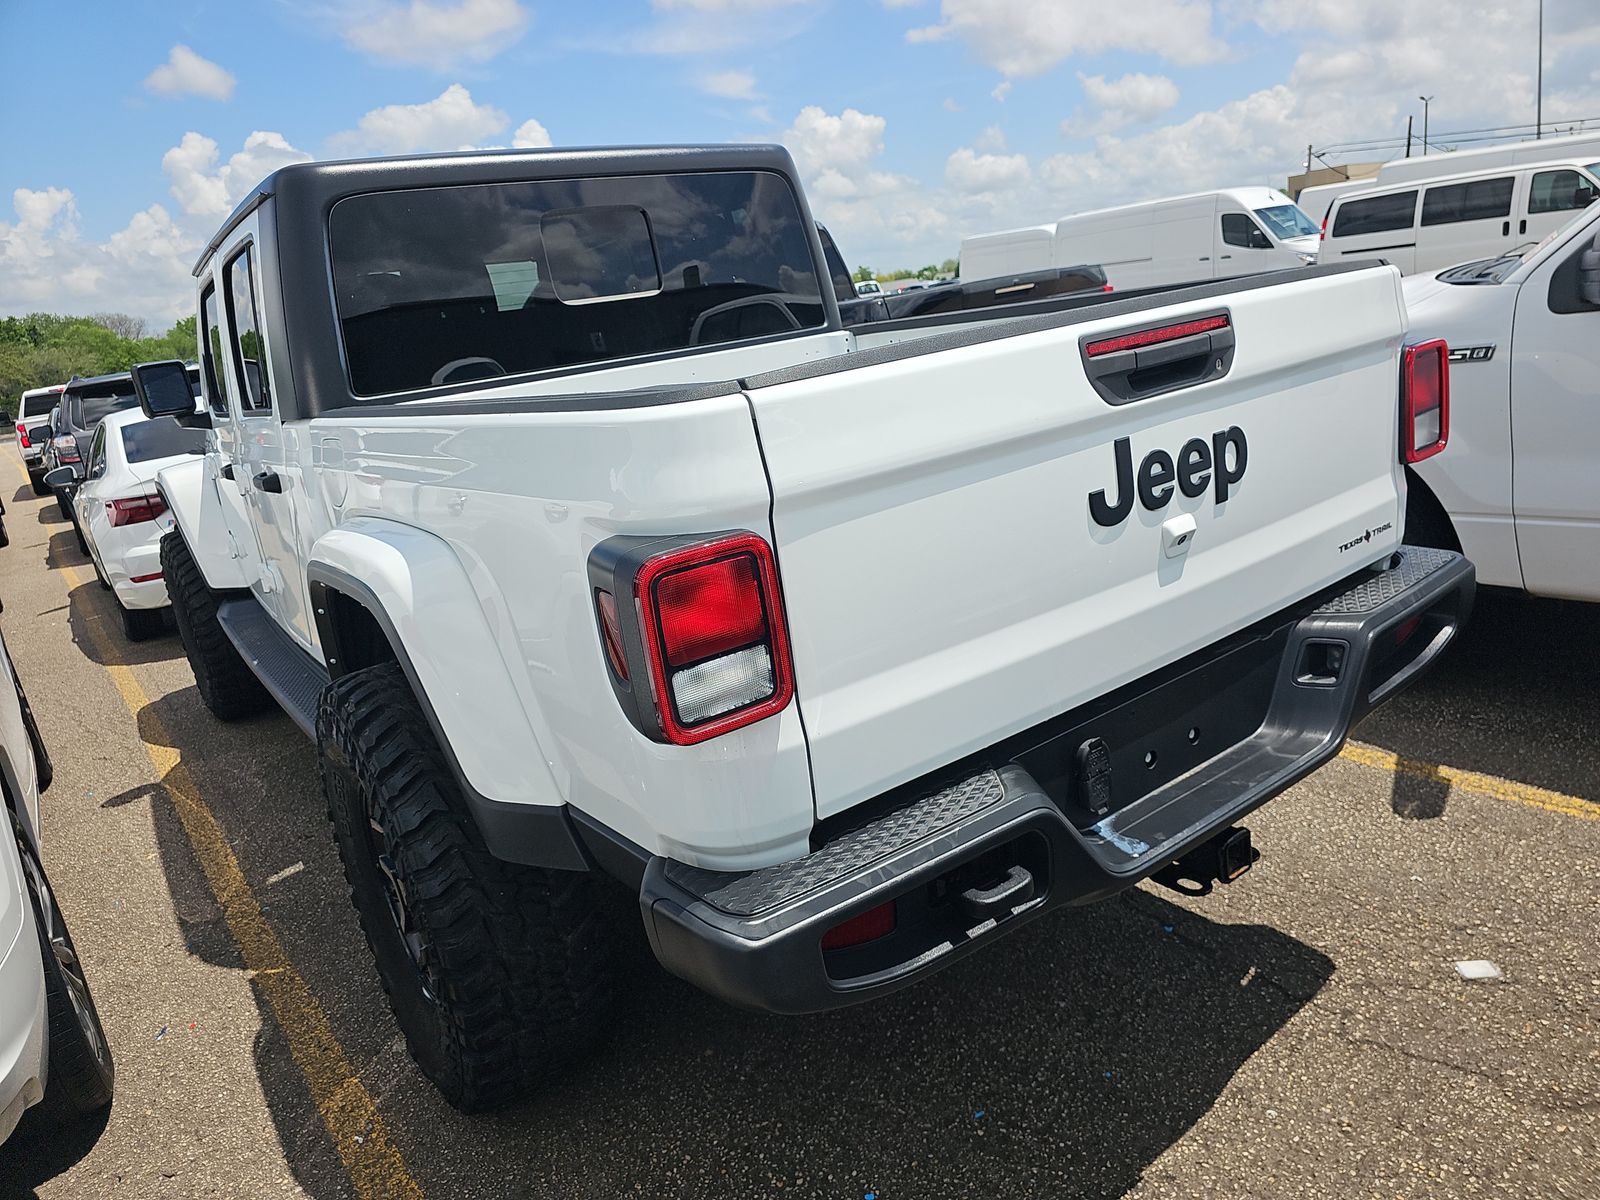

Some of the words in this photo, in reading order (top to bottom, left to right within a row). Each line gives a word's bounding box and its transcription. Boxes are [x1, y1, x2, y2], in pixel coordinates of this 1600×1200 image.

[1088, 425, 1248, 527] Jeep
[1338, 536, 1363, 553] TEXAS
[1372, 522, 1392, 536] TRAIL
